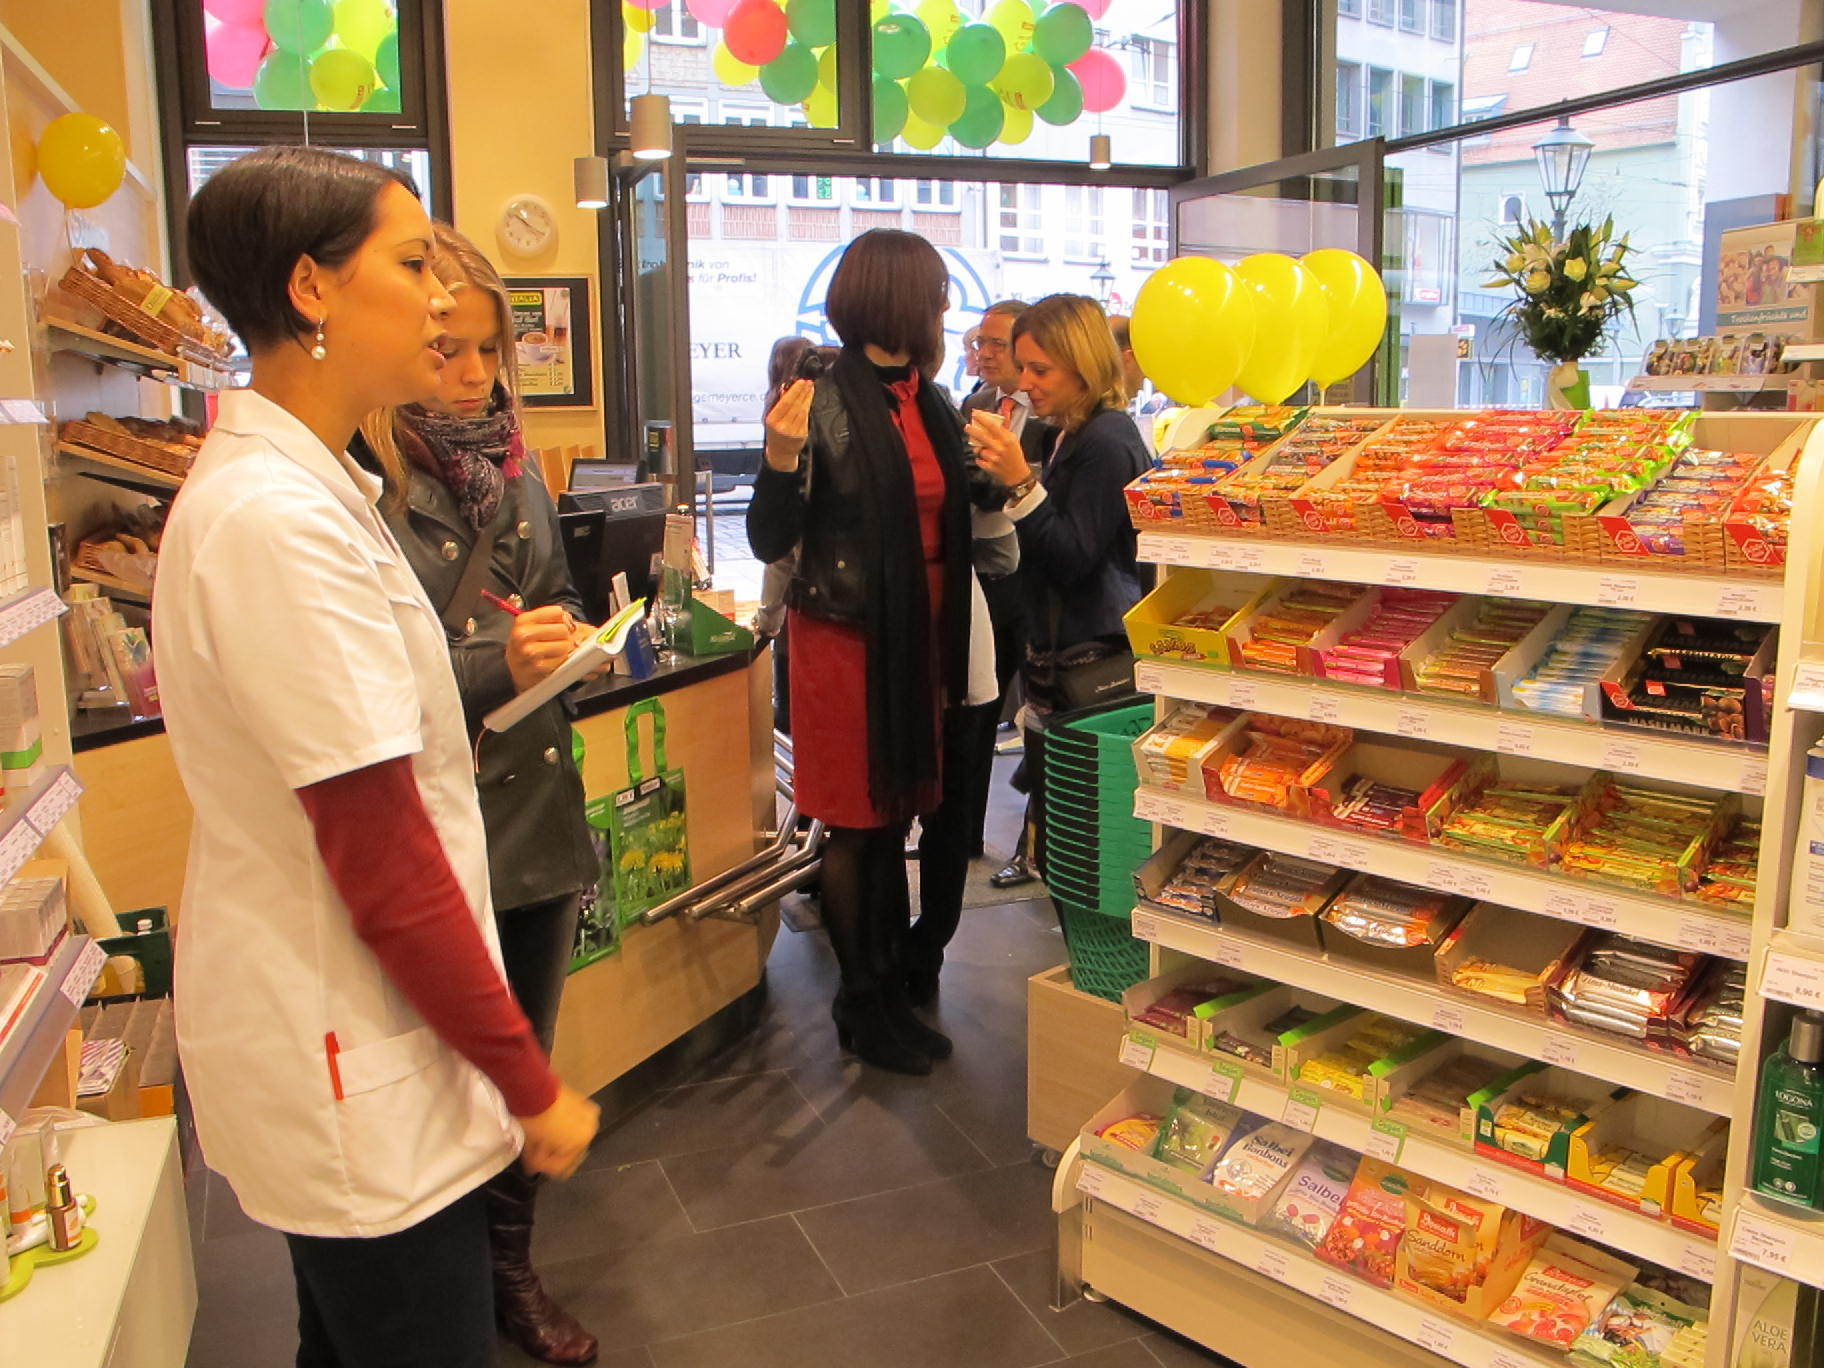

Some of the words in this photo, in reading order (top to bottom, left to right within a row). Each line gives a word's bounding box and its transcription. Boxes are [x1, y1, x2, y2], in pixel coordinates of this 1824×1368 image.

[709, 261, 730, 269] von
[717, 272, 757, 284] Profis!
[511, 295, 541, 304] ITALIA
[690, 342, 742, 359] EYER
[610, 496, 638, 512] acer
[1775, 1089, 1813, 1108] LOGONA
[1243, 1143, 1289, 1168] Bonbons
[1254, 1136, 1295, 1157] Salbei
[1298, 1174, 1342, 1204] Salbe
[1407, 1229, 1465, 1263] Sanddorn
[1753, 1319, 1789, 1341] ALOE
[1751, 1331, 1788, 1354] VERA
